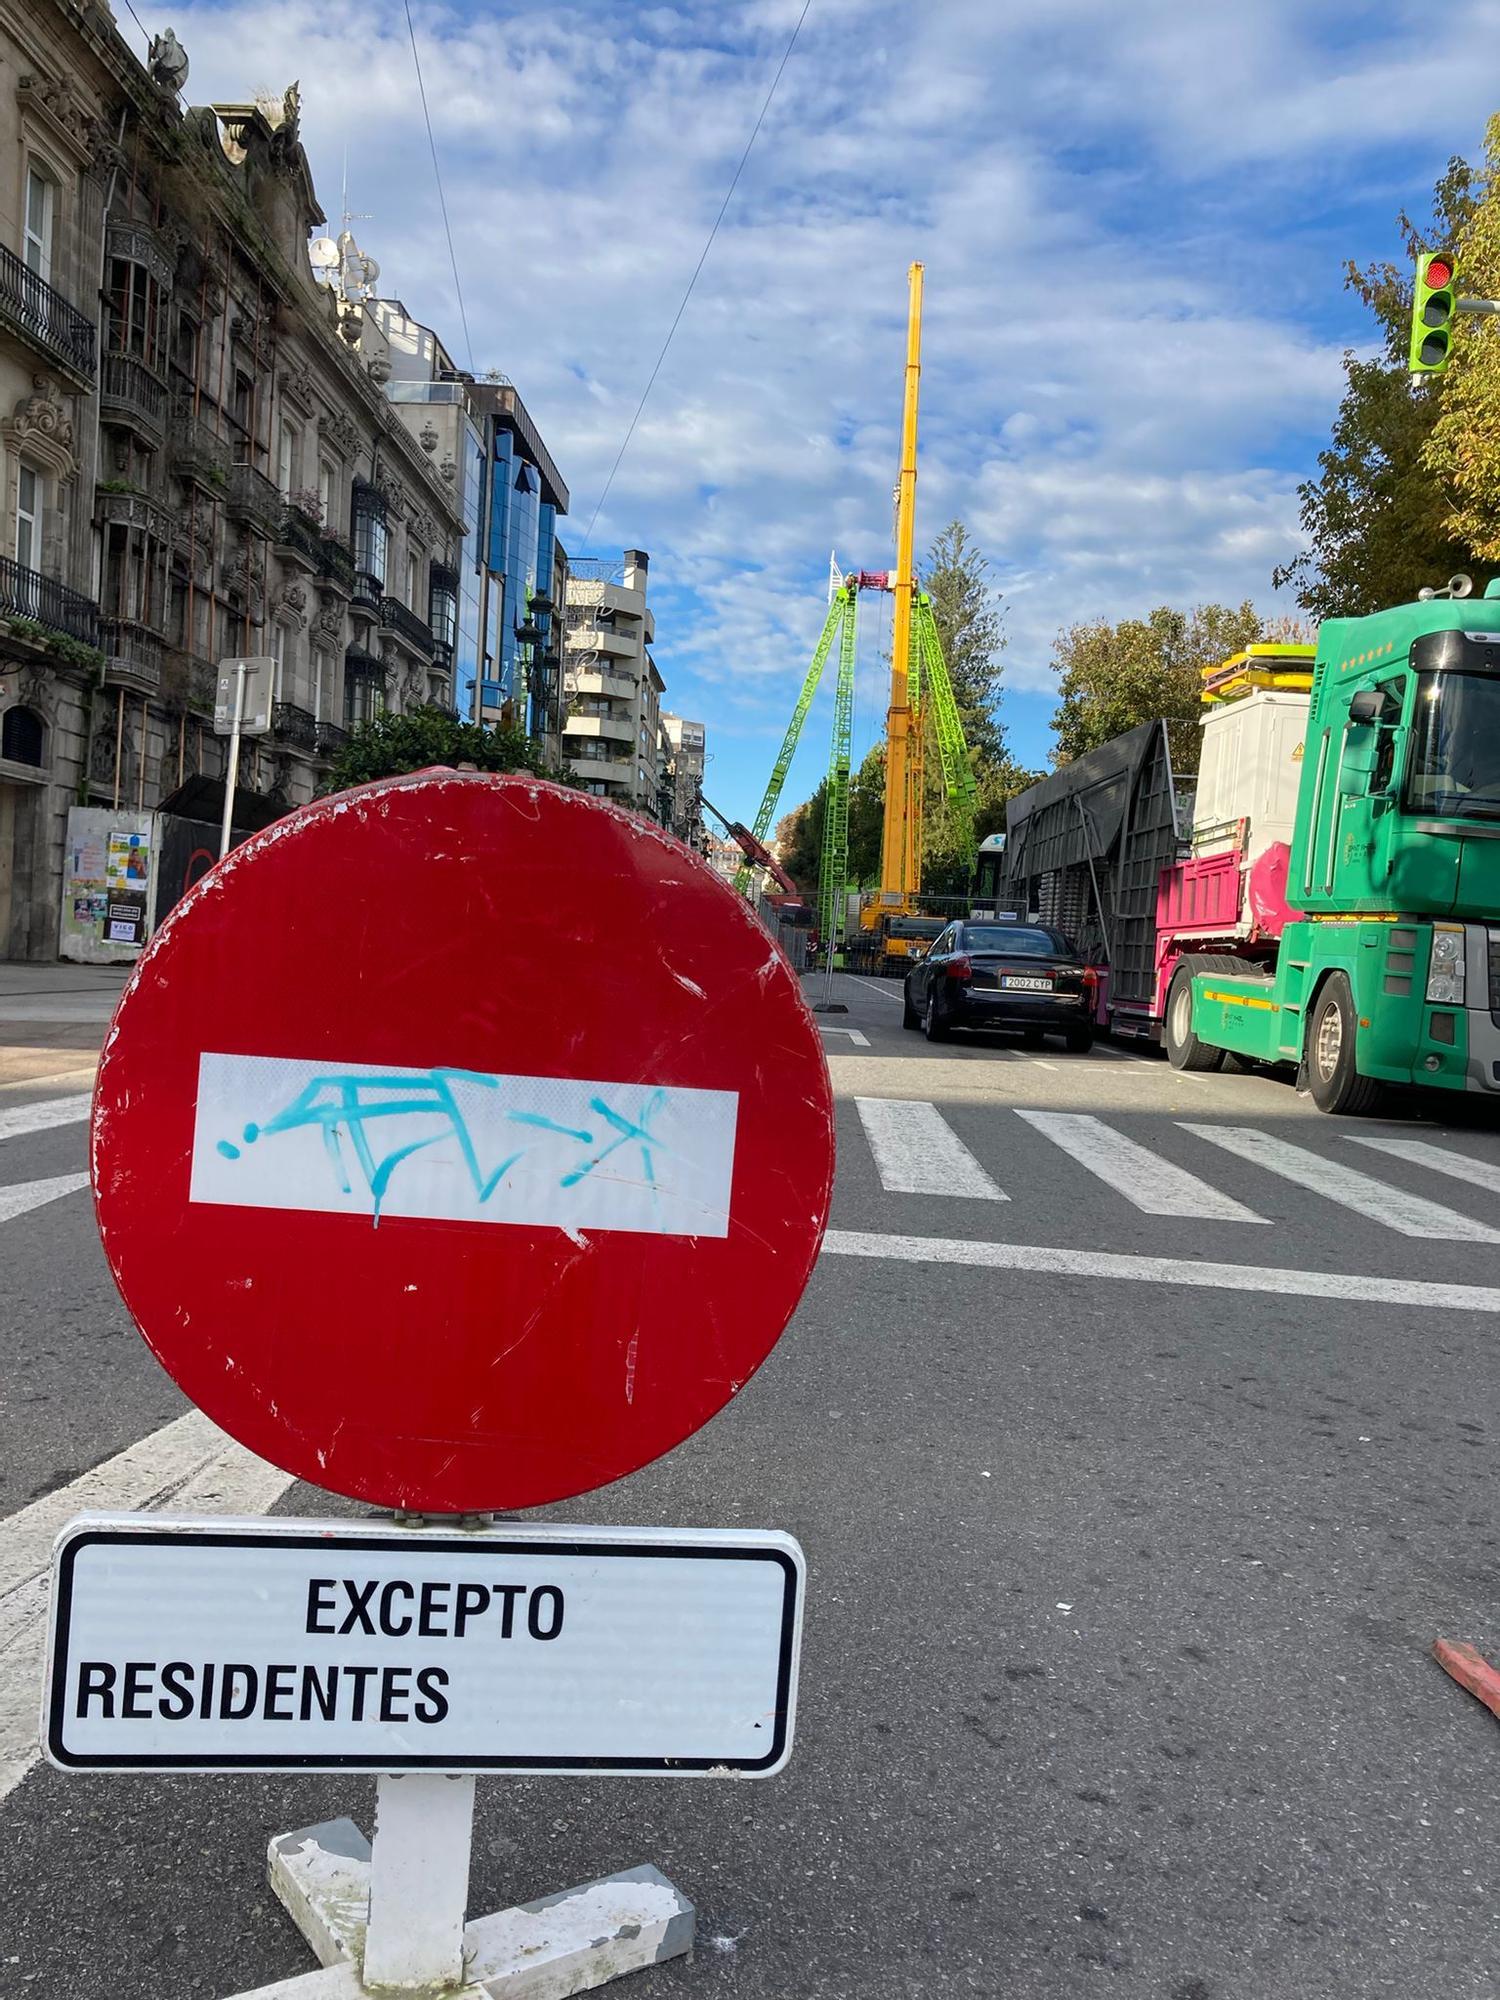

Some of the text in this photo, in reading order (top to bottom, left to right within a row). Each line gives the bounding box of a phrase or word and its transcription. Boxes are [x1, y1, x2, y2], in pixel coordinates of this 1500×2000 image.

[1008, 978, 1051, 989] 2002 CYP
[305, 1578, 565, 1641] EXCEPTO
[76, 1661, 451, 1724] RESIDENTES
